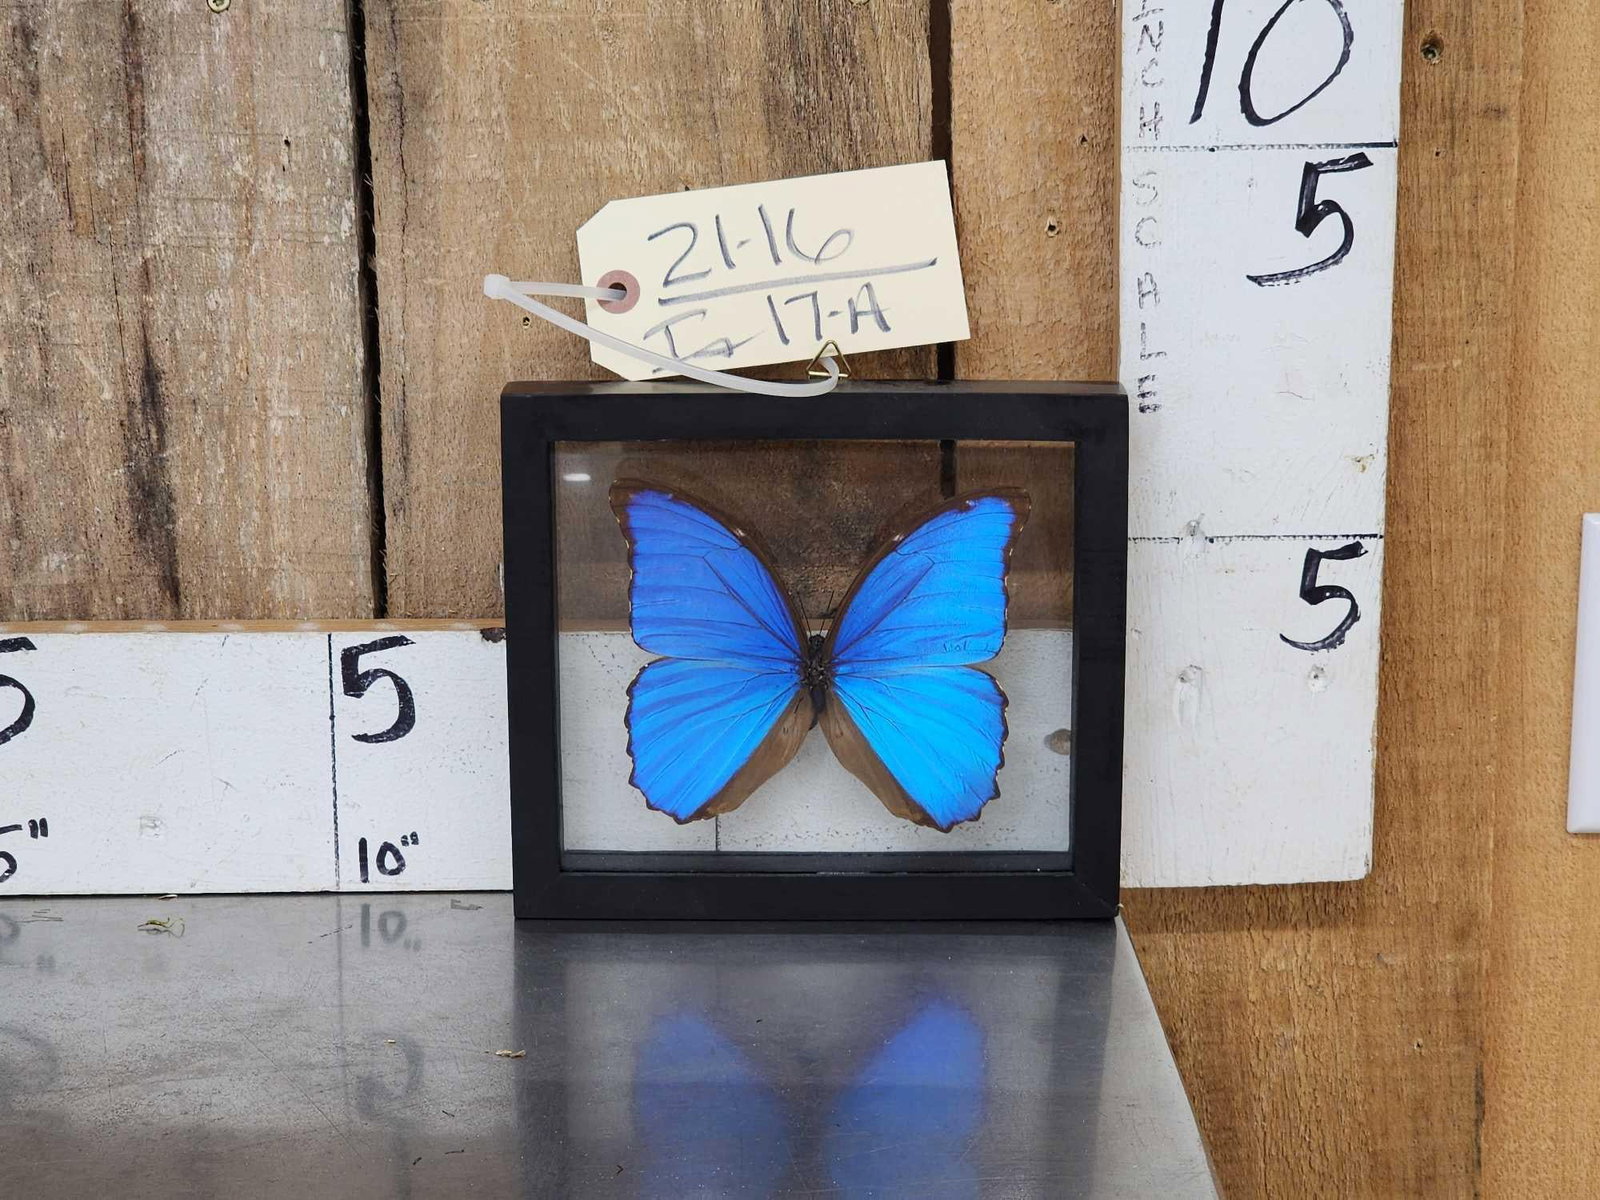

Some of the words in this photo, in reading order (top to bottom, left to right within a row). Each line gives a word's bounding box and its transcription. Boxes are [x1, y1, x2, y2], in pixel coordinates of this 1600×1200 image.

[1188, 0, 1355, 127] 10
[647, 203, 853, 288] 21-16
[1246, 151, 1373, 287] 5
[766, 281, 892, 346] 17-A
[1280, 540, 1367, 652] 5
[340, 635, 417, 744] 5
